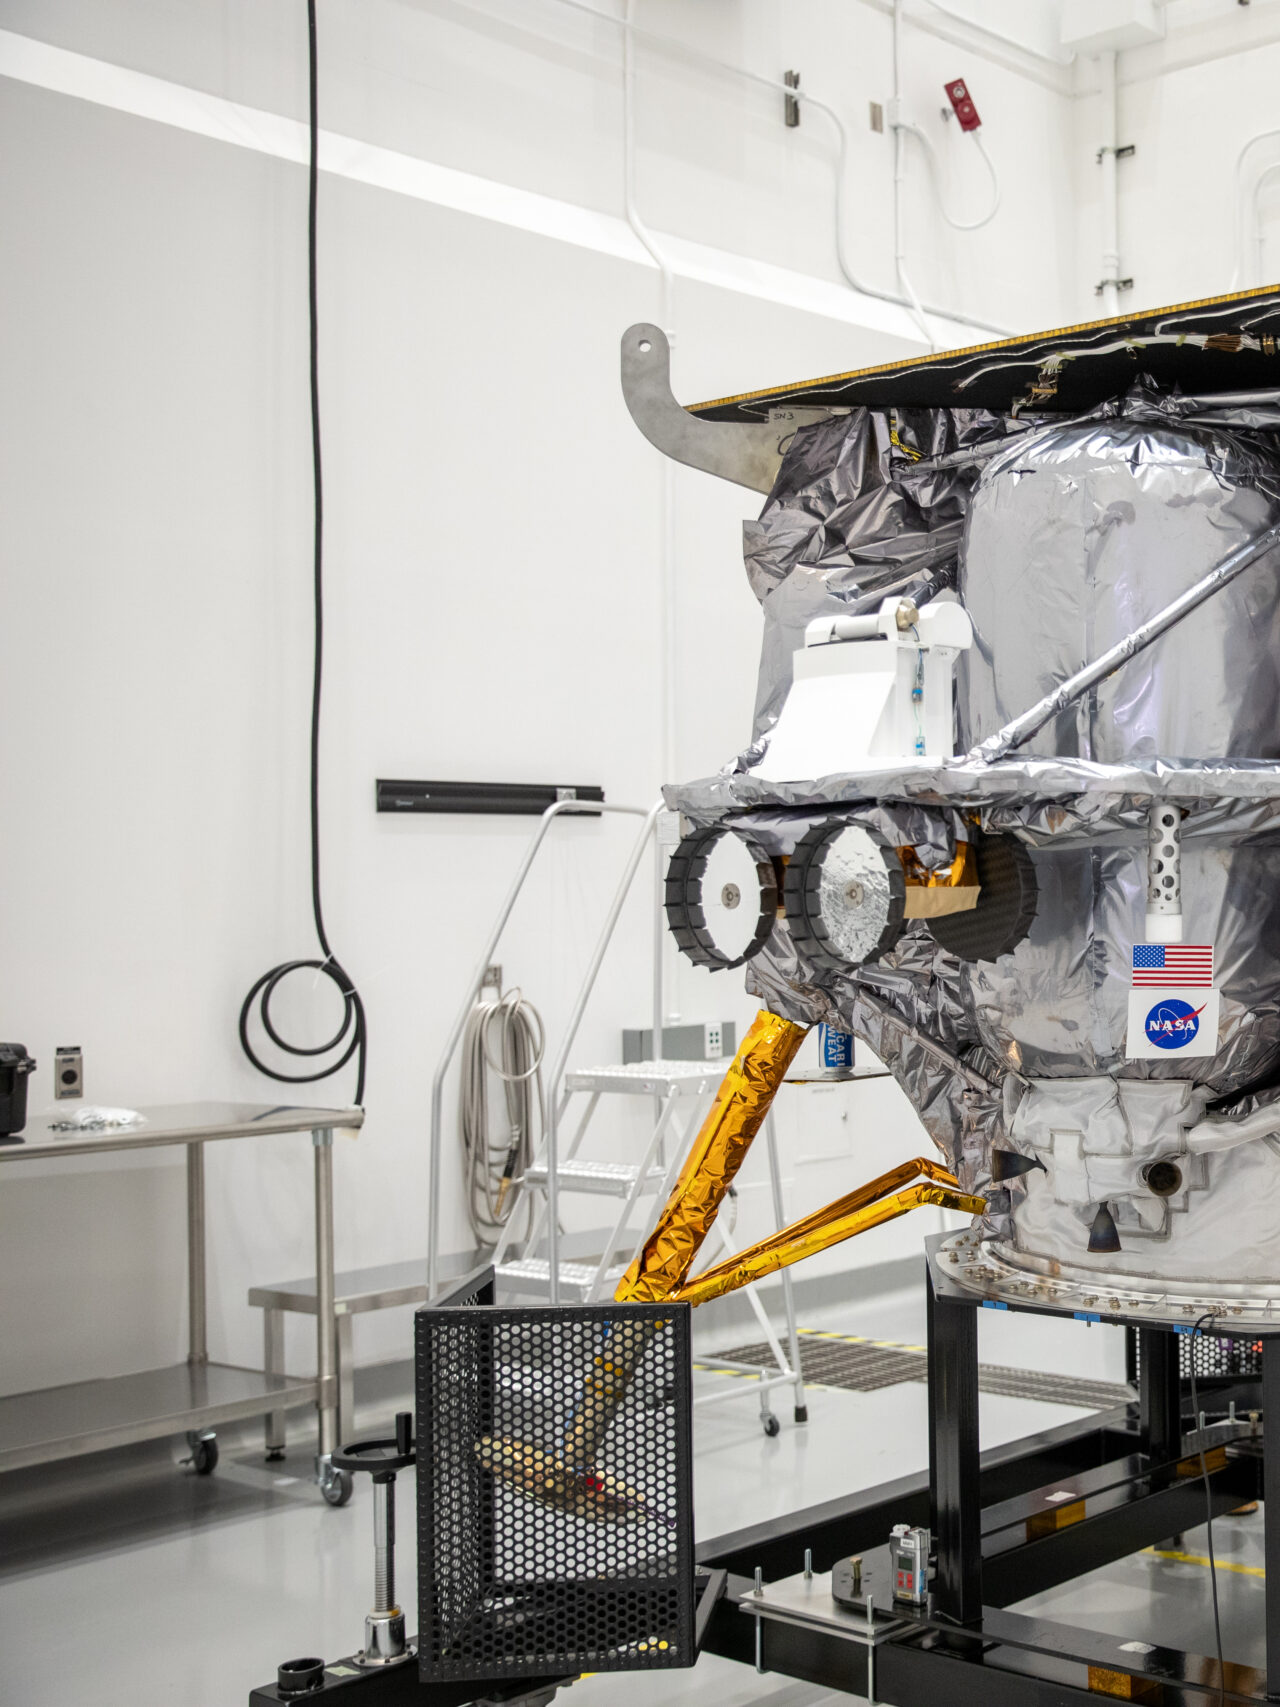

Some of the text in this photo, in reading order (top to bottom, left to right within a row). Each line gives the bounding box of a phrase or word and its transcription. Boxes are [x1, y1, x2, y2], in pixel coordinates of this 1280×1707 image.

[1149, 1019, 1197, 1032] NASA
[827, 1026, 837, 1063] WEAT
[836, 1032, 846, 1067] CARI
